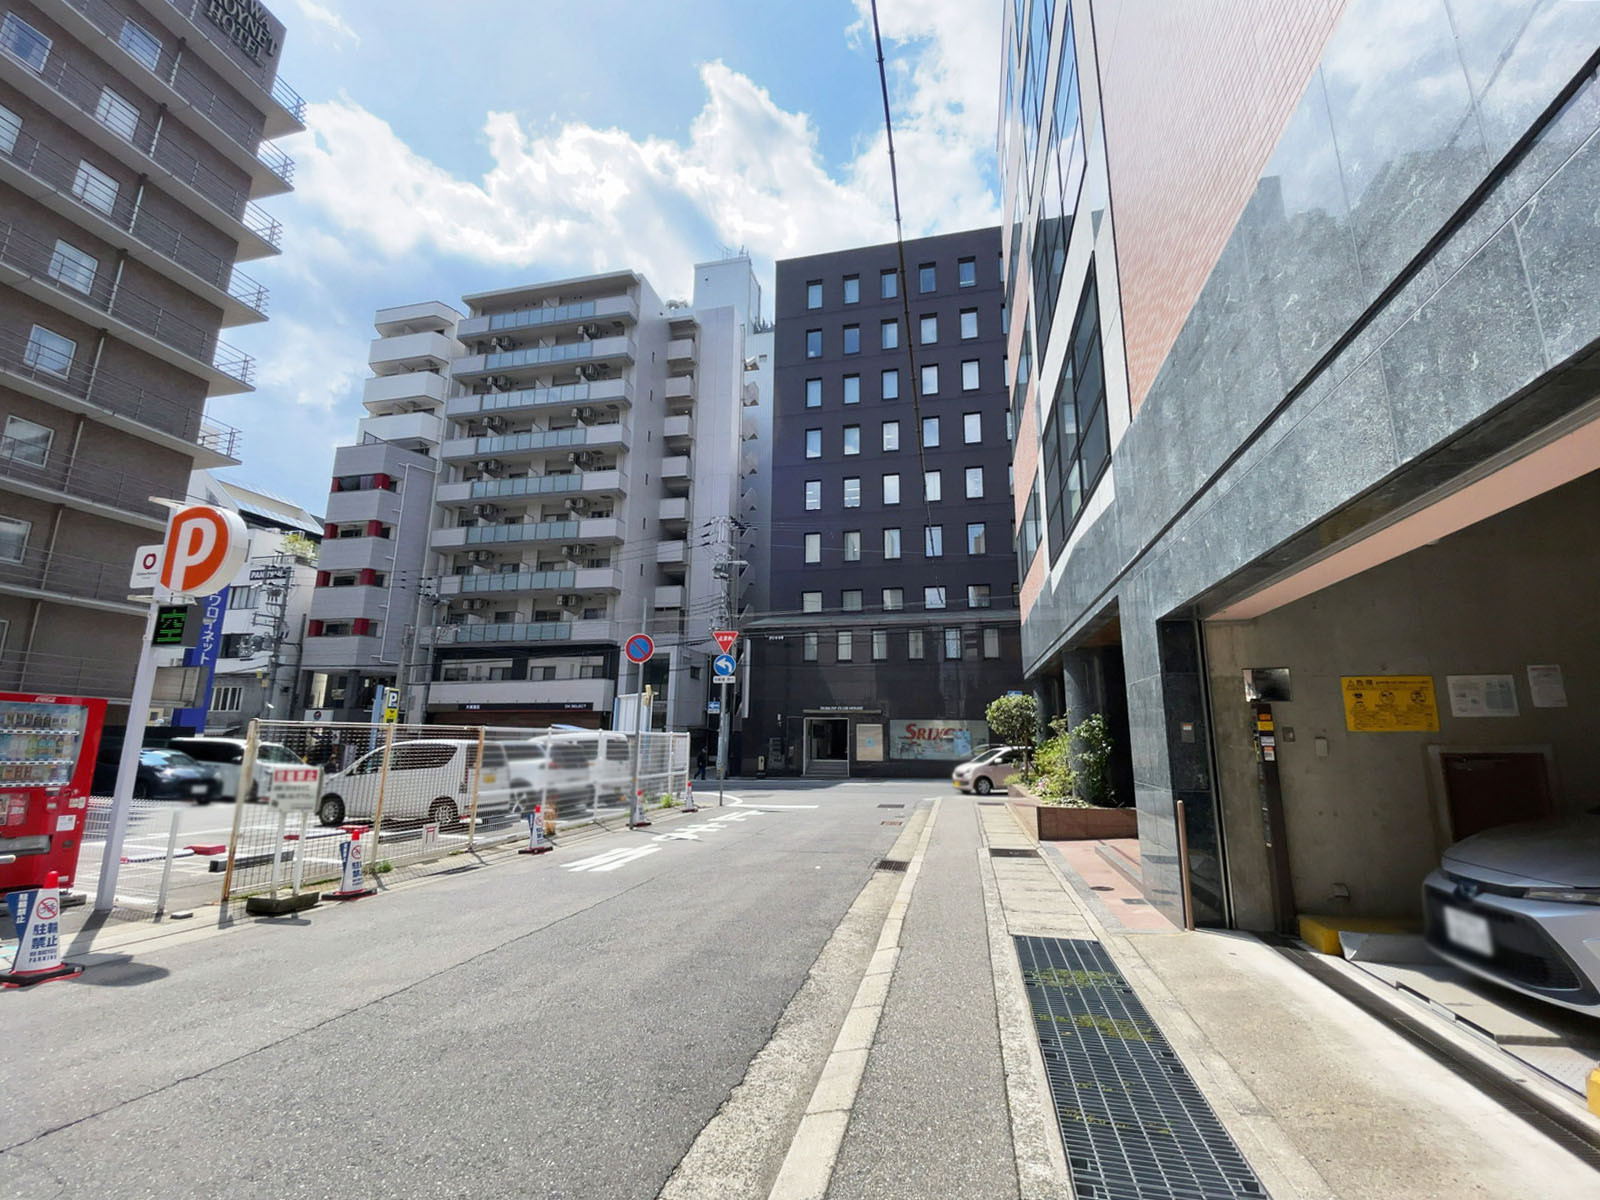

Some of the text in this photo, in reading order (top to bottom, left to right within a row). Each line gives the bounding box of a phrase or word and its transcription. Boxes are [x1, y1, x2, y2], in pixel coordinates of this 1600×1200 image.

[206, 0, 264, 67] HOTEL
[156, 609, 187, 643] 空
[904, 723, 970, 741] SRIXO
[32, 935, 58, 949] 禁止
